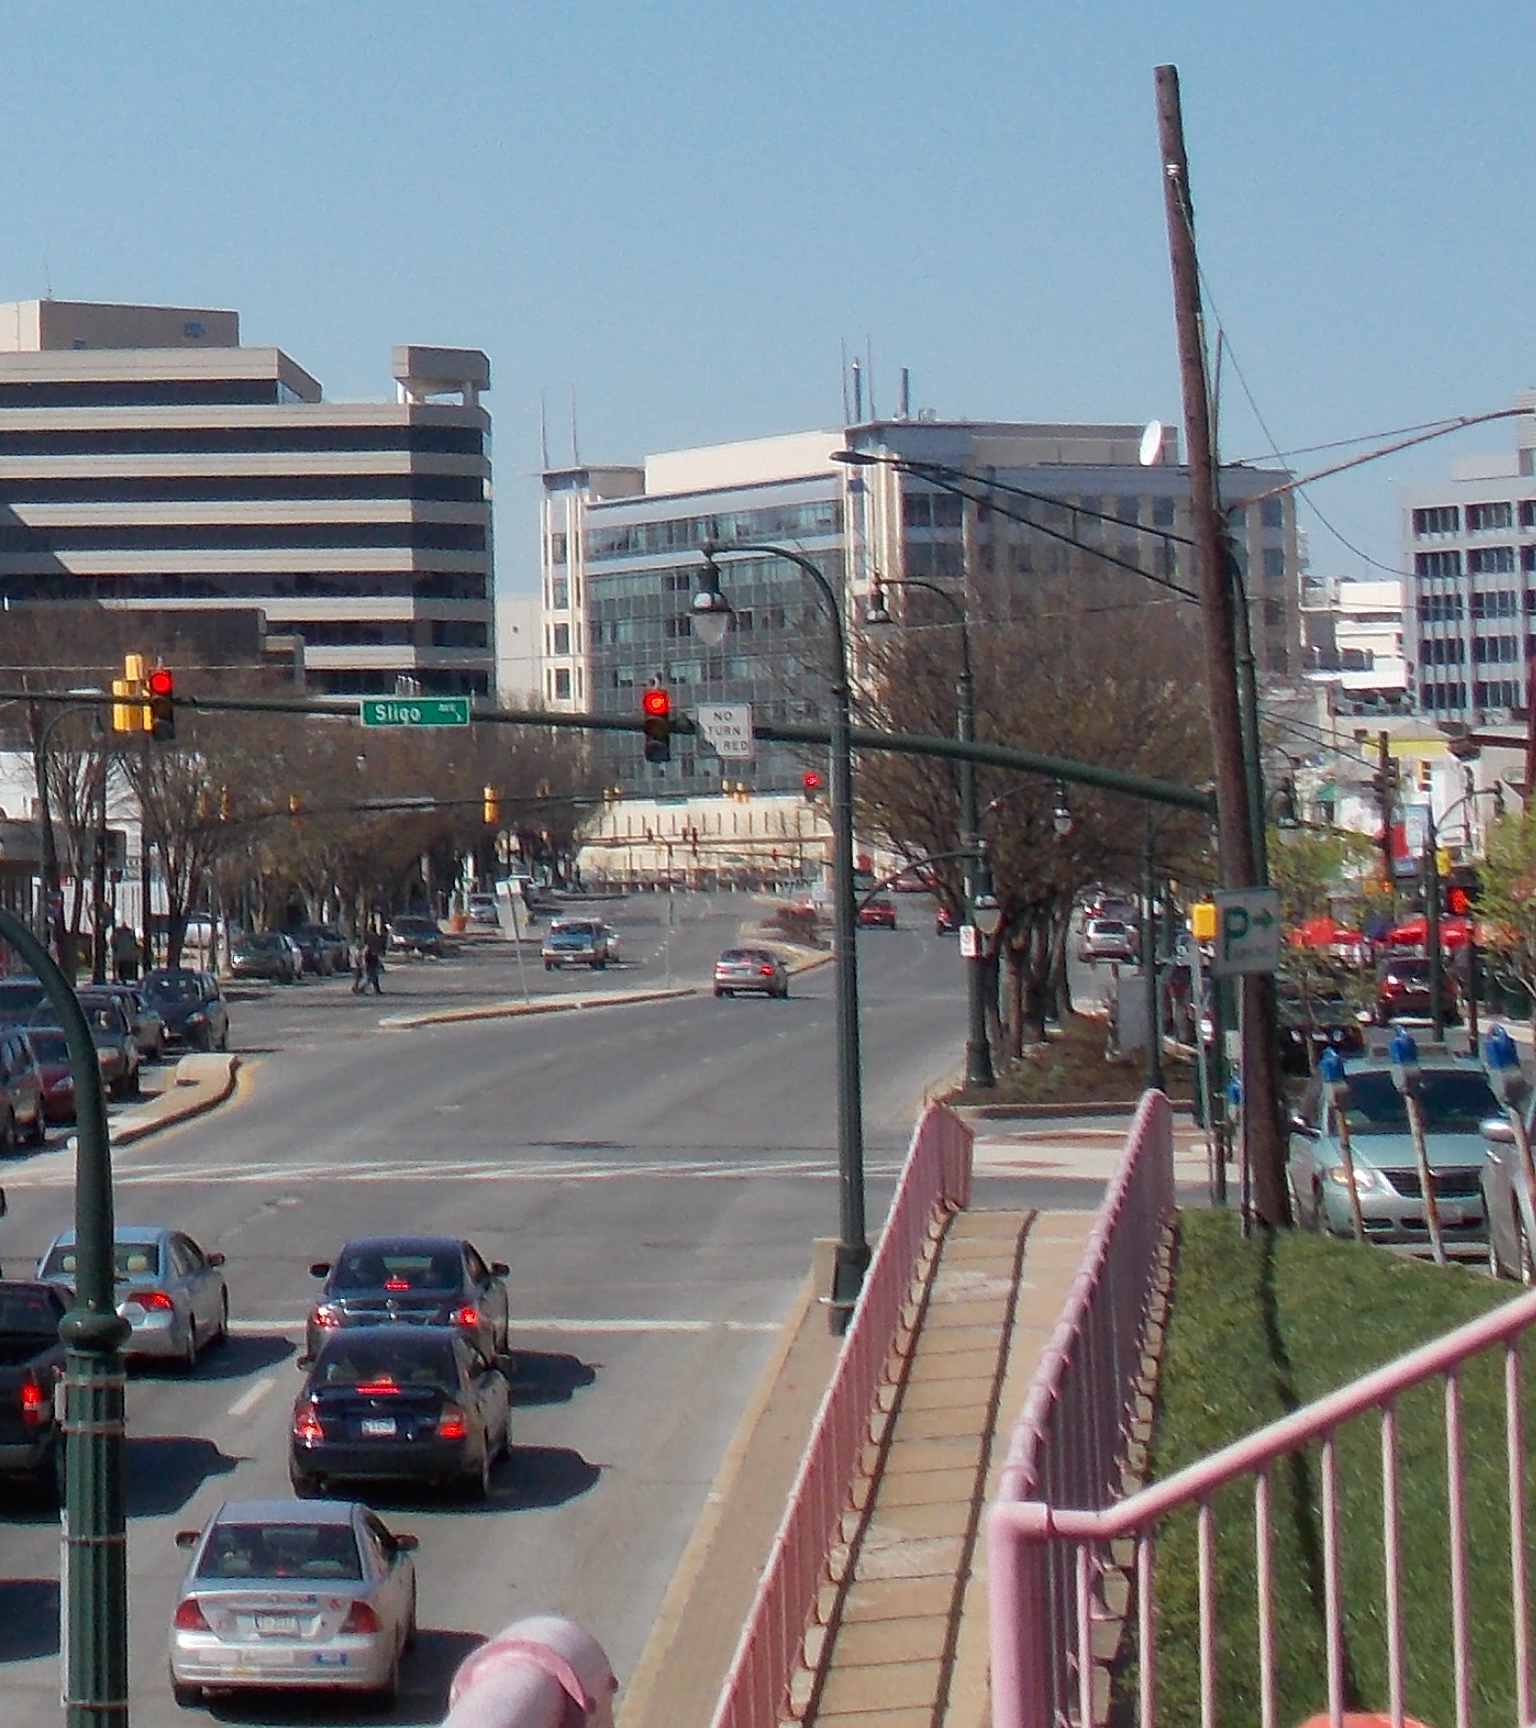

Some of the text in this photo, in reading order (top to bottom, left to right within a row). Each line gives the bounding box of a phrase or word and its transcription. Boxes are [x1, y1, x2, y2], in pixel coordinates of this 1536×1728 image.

[375, 703, 422, 725] Sligo
[713, 711, 733, 721] NO
[708, 725, 742, 736] TURN
[723, 740, 748, 751] RED
